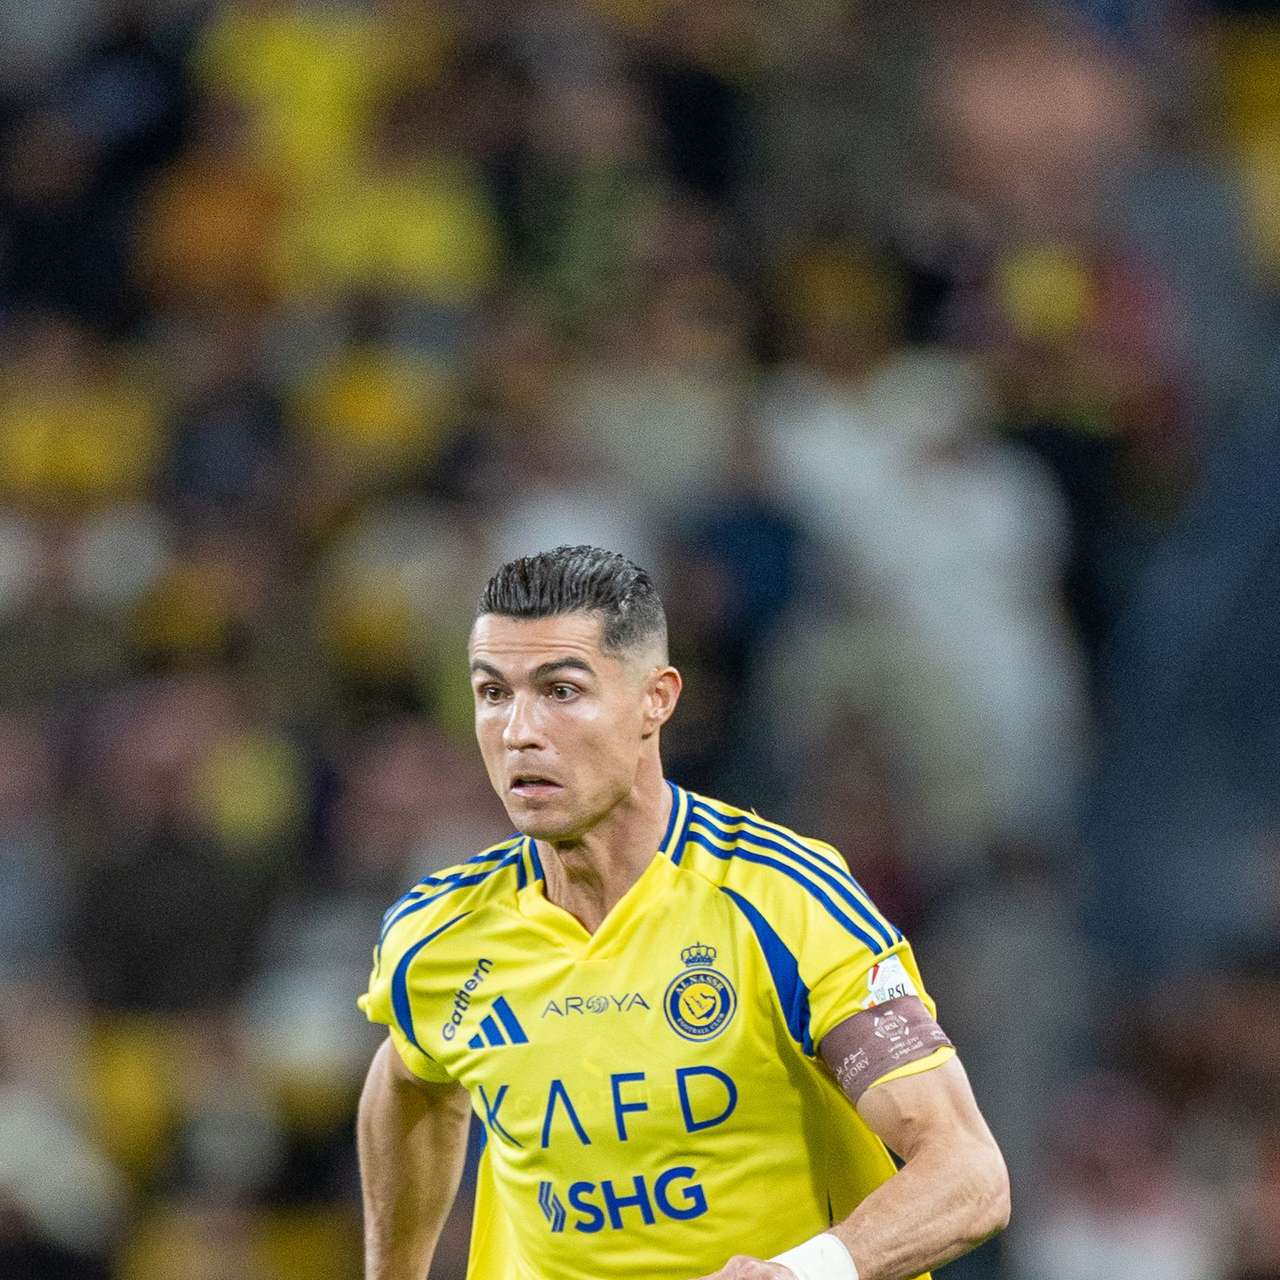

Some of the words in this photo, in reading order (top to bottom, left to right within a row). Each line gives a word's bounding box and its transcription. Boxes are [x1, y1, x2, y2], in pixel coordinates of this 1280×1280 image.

[442, 957, 494, 1042] Gathern
[542, 992, 651, 1019] AROYA
[887, 983, 908, 1000] RSL
[478, 1065, 738, 1149] KAFD
[567, 1166, 709, 1234] SHG
